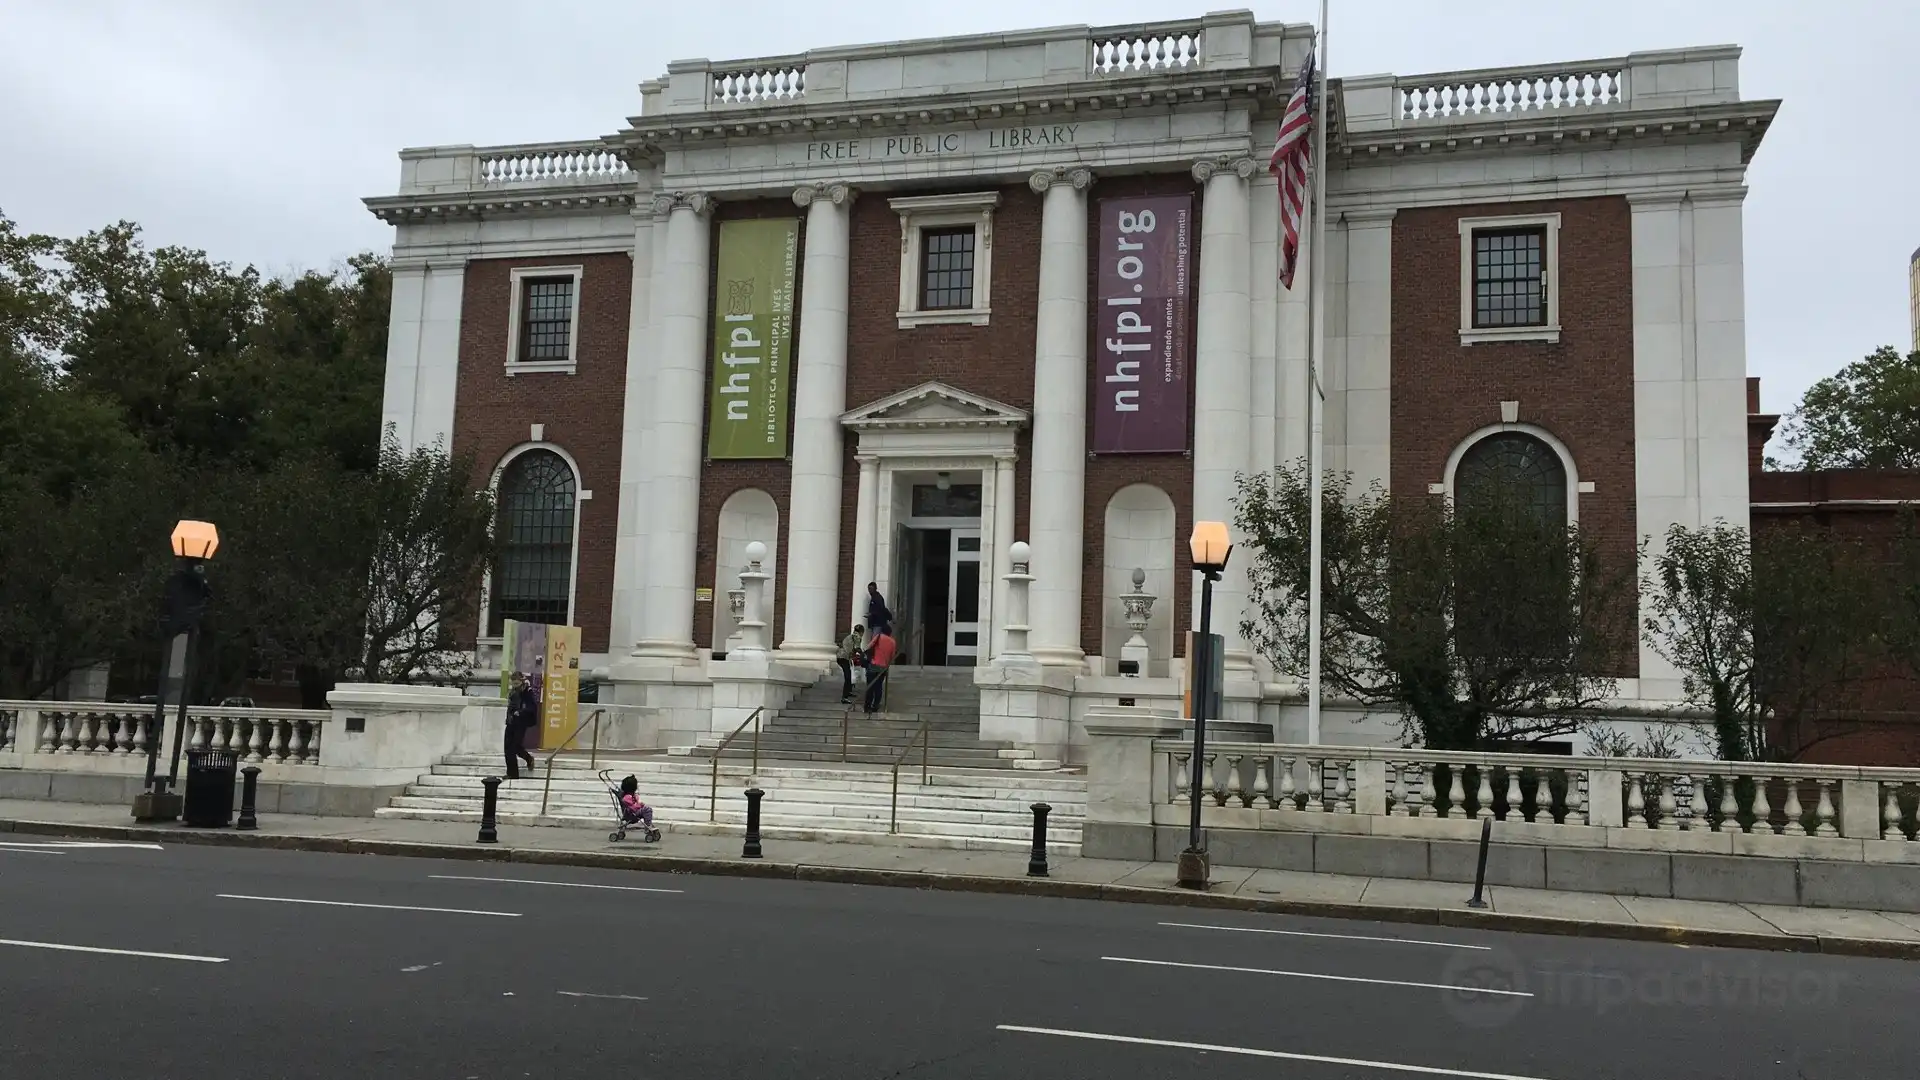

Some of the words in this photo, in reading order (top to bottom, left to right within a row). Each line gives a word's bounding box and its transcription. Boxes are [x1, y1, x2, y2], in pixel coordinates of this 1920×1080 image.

[807, 141, 860, 160] FREE
[886, 133, 959, 156] PUBLIC
[989, 124, 1079, 148] LIBRARY
[1177, 209, 1187, 248] potential
[785, 230, 795, 277] LIBRARY
[1177, 248, 1187, 295] unleashing
[773, 288, 782, 314] IVES
[783, 280, 792, 312] MAIN
[1105, 209, 1156, 412] nhfpl.org
[1165, 298, 1173, 328] mentes
[770, 316, 780, 374] PRINCIPAL
[782, 315, 790, 339] IVES
[720, 313, 761, 420] nhfpl
[1164, 329, 1173, 382] expandiendo
[767, 377, 777, 443] BIBLIOTECA
